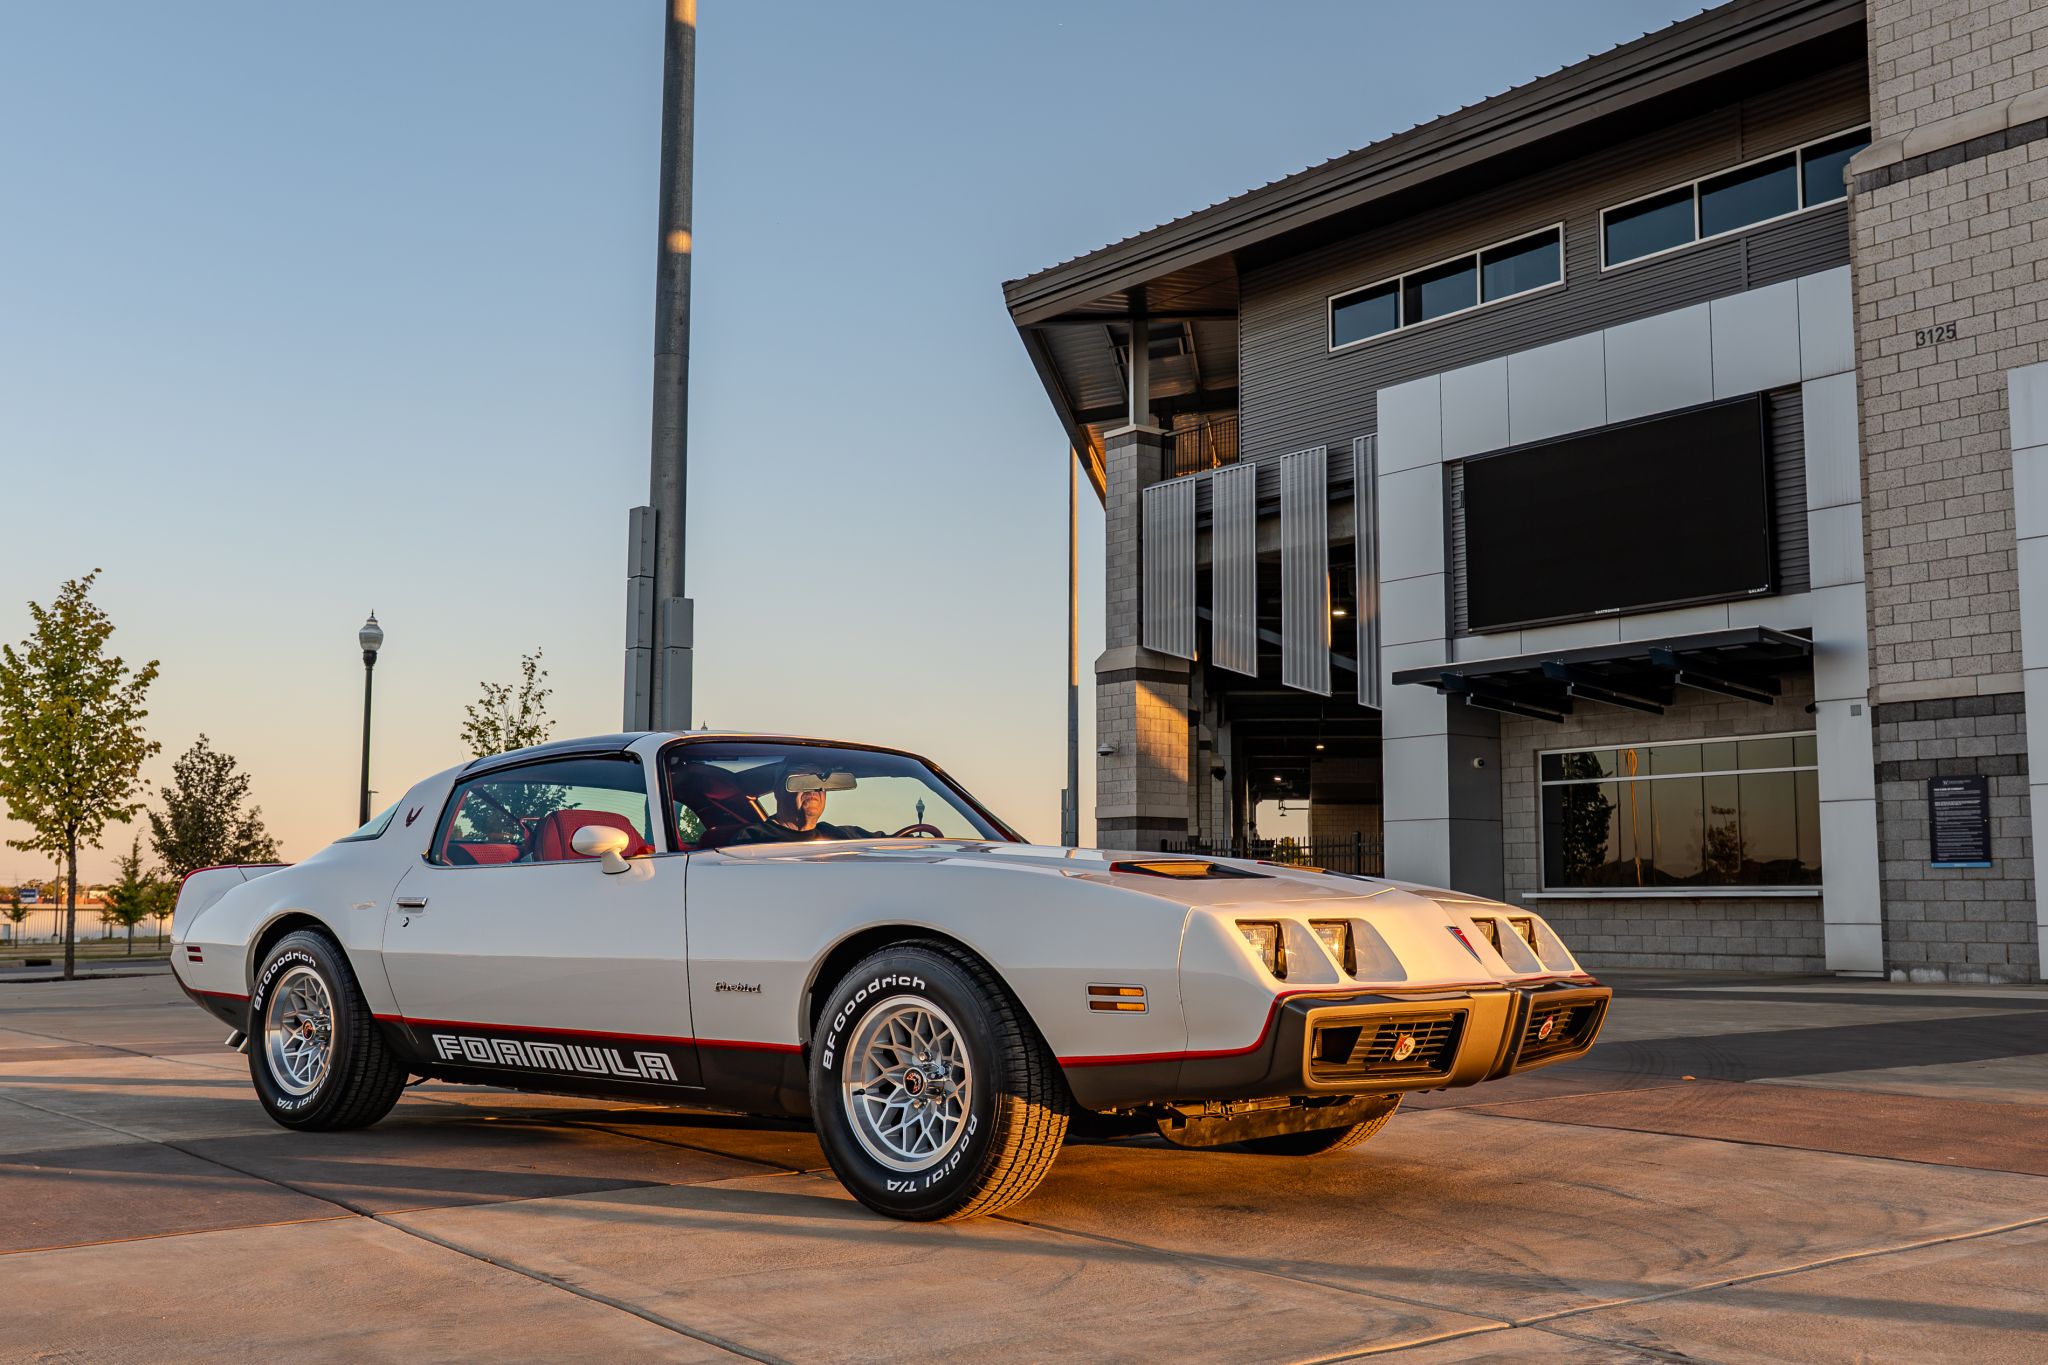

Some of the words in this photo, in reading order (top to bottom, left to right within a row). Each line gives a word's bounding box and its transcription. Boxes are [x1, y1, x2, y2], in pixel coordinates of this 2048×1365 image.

[1917, 322, 1956, 346] 3125
[254, 951, 316, 1011] BFGoodrich
[823, 974, 926, 1070] BFGoodrich
[432, 1034, 678, 1081] FORMULA
[277, 1096, 294, 1110] T/A
[925, 1113, 977, 1189] Radial
[887, 1179, 917, 1193] T/A
